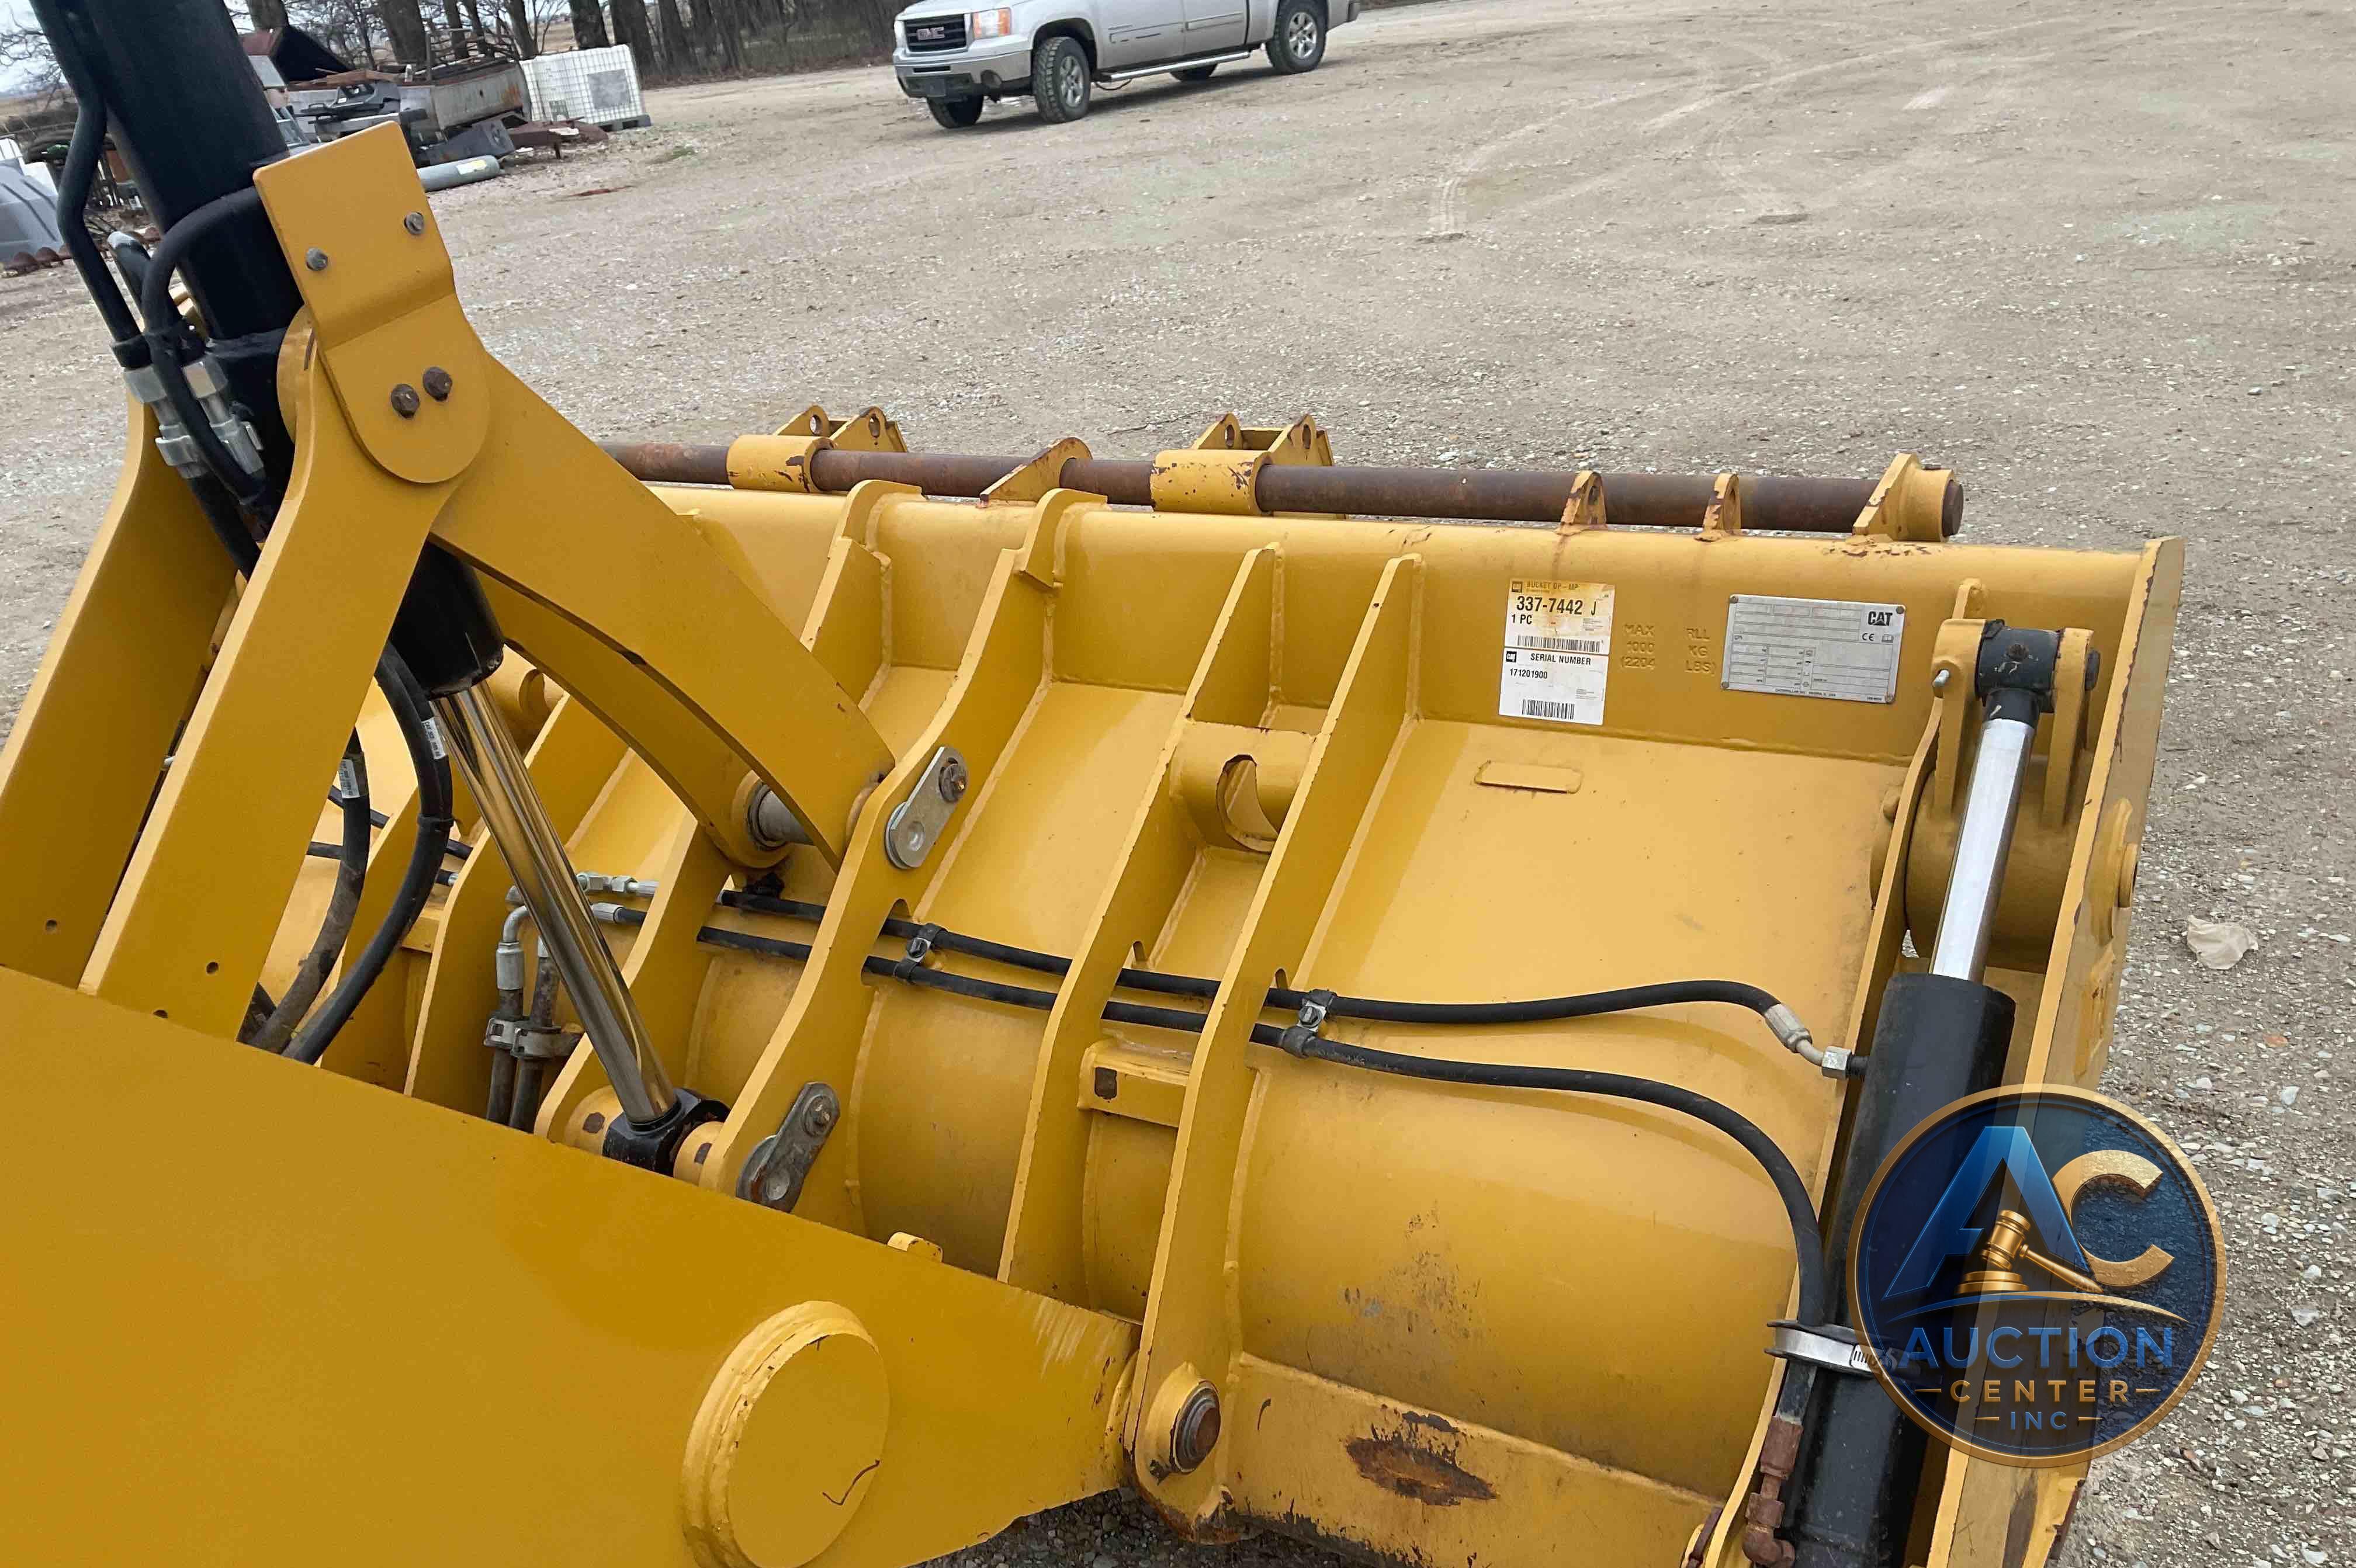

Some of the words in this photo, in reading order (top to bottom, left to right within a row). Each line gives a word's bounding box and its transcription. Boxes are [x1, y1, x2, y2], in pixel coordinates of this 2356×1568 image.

[1516, 595, 1583, 615] 337-7442
[1512, 614, 1516, 623] 1
[1520, 614, 1532, 625] PC
[1868, 611, 1893, 626] CAT
[1624, 624, 1654, 636] MAX
[1688, 645, 1708, 658] KG
[1530, 653, 1556, 663] SERIAL
[1558, 657, 1591, 665] NUMBER
[1509, 668, 1548, 679] 171201900
